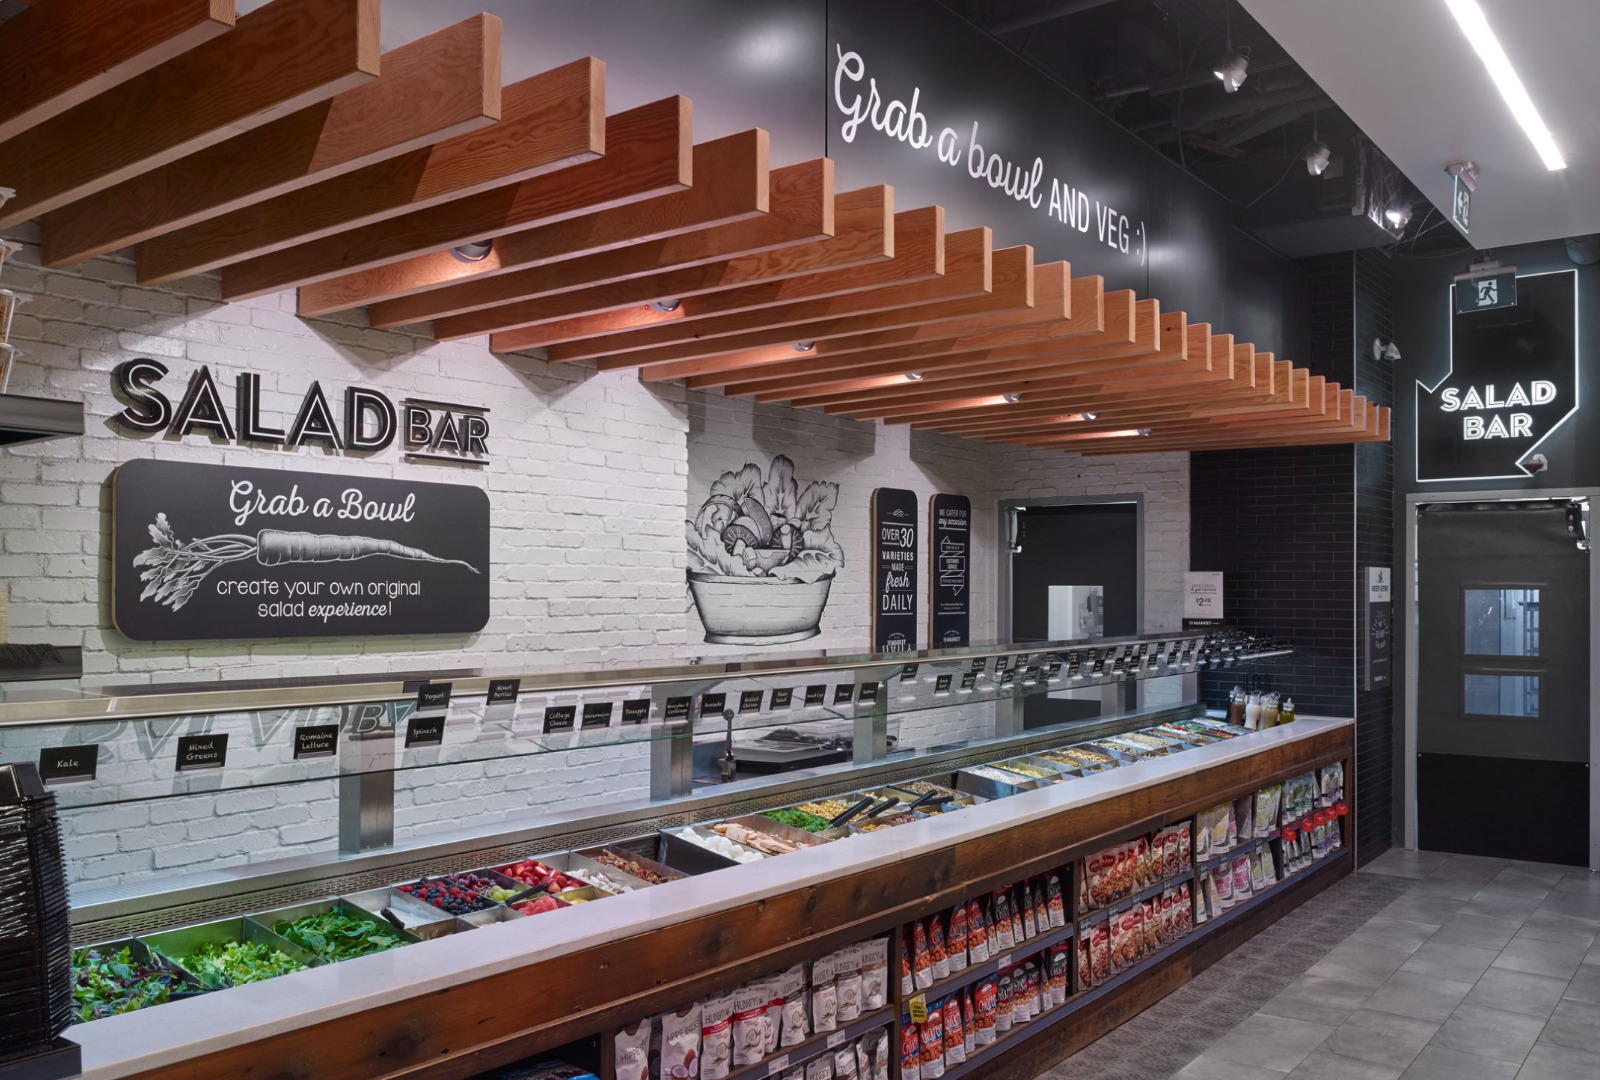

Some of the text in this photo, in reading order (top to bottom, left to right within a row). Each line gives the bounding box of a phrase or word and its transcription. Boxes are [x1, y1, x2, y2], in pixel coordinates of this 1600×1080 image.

[835, 43, 933, 150] Grab
[937, 127, 962, 166] a
[967, 121, 1043, 209] bowl
[1049, 178, 1090, 233] AND
[1096, 201, 1130, 255] VEG
[1440, 380, 1557, 412] SALAD
[115, 358, 490, 454] SALAD BAR
[1463, 412, 1533, 440] BAR
[229, 479, 416, 526] Grab a Bowl
[882, 528, 914, 548] OVER 30
[882, 551, 914, 561] VARIETIES
[891, 563, 905, 572] MADE
[217, 578, 421, 599] create your own original
[885, 571, 910, 593] fresh
[882, 594, 913, 611] DAILY
[258, 600, 393, 623] salad experience!
[424, 692, 445, 702] Yogurt
[548, 712, 571, 721] Cottage
[300, 732, 334, 742] Romaine
[413, 728, 438, 739] Spinach
[189, 742, 215, 752] Mixed
[301, 740, 330, 750] Lettuce
[56, 758, 80, 769] Kale
[186, 751, 219, 762] Greens
